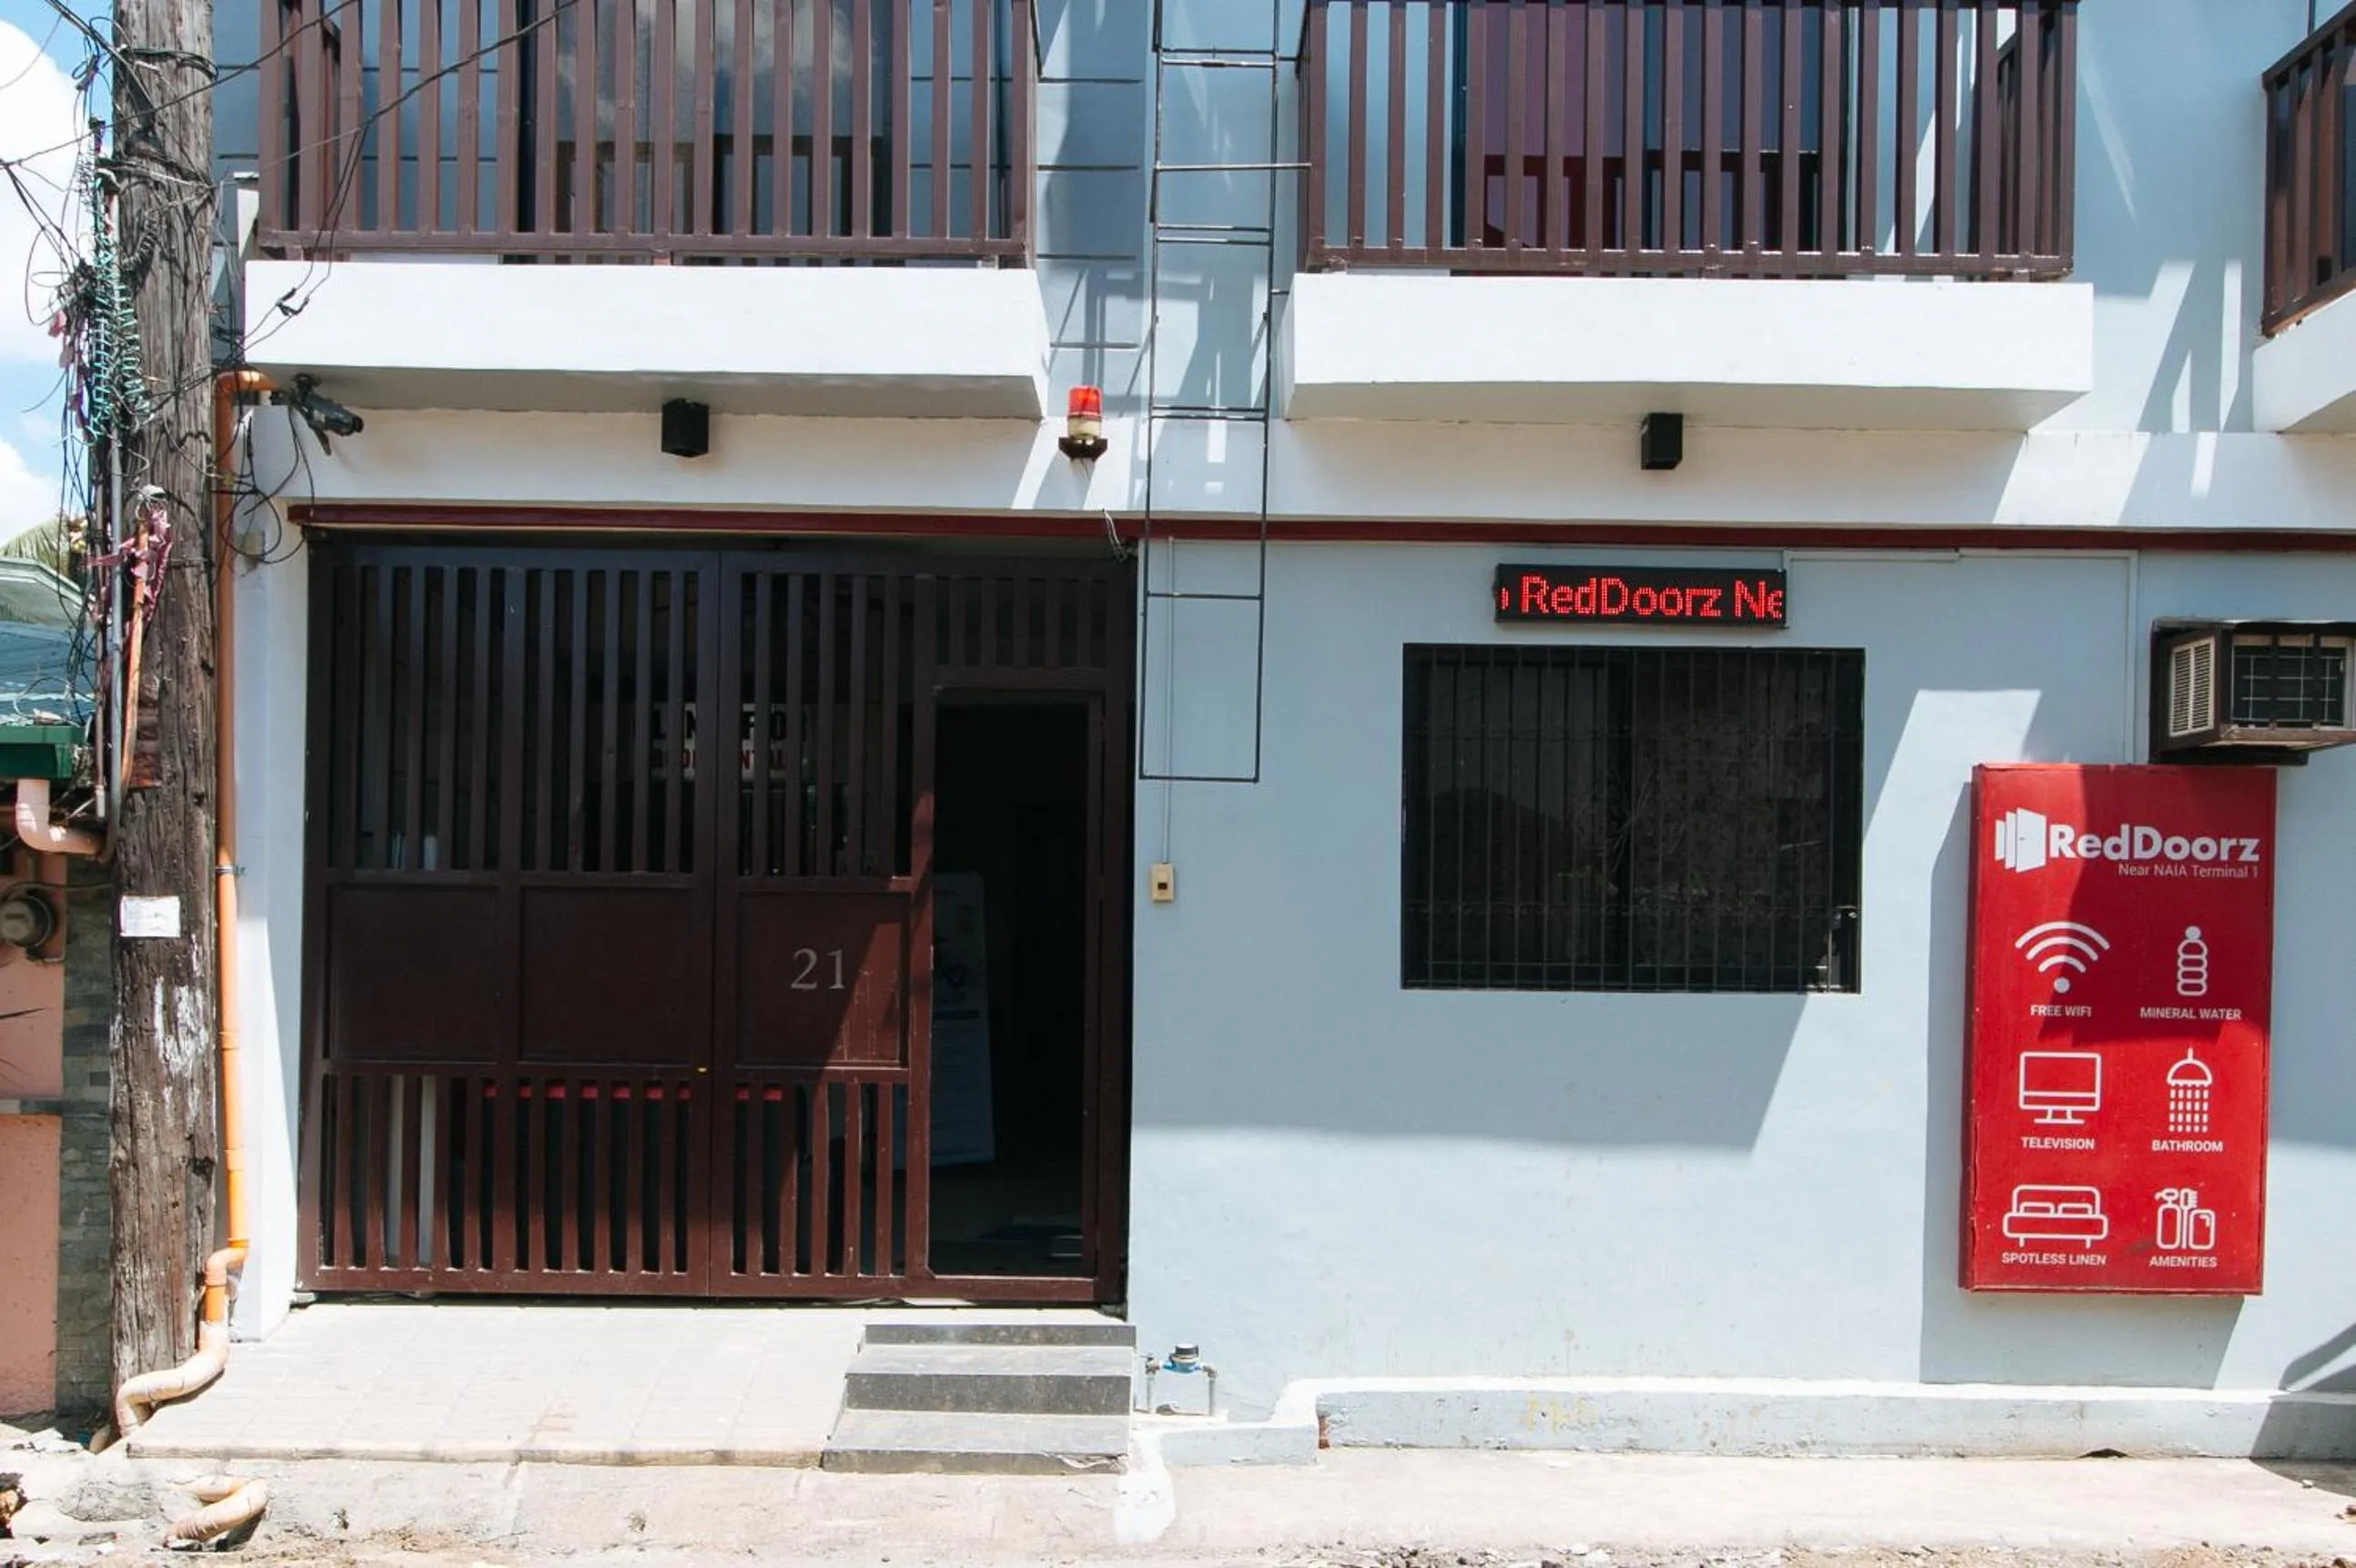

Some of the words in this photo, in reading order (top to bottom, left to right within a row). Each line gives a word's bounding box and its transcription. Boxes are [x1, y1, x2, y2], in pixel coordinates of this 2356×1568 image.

[1522, 576, 1722, 616] RedDoorz
[2049, 824, 2260, 862] RedDoorz
[2118, 864, 2149, 877] Near
[2154, 865, 2187, 877] NAIA
[2193, 865, 2249, 878] Terminal
[2252, 866, 2259, 878] 1
[791, 948, 845, 989] 21
[2030, 1005, 2062, 1017] FREE
[2063, 1006, 2092, 1017] WIFI
[2140, 1007, 2197, 1019] MINERAL
[2199, 1008, 2241, 1020] WATER
[2020, 1137, 2095, 1150] TELEVISION
[2152, 1139, 2223, 1152] BATHROOM
[2001, 1252, 2066, 1265] SPOTLESS
[2068, 1254, 2107, 1266] LINEN
[2149, 1256, 2218, 1268] AMENITIES
